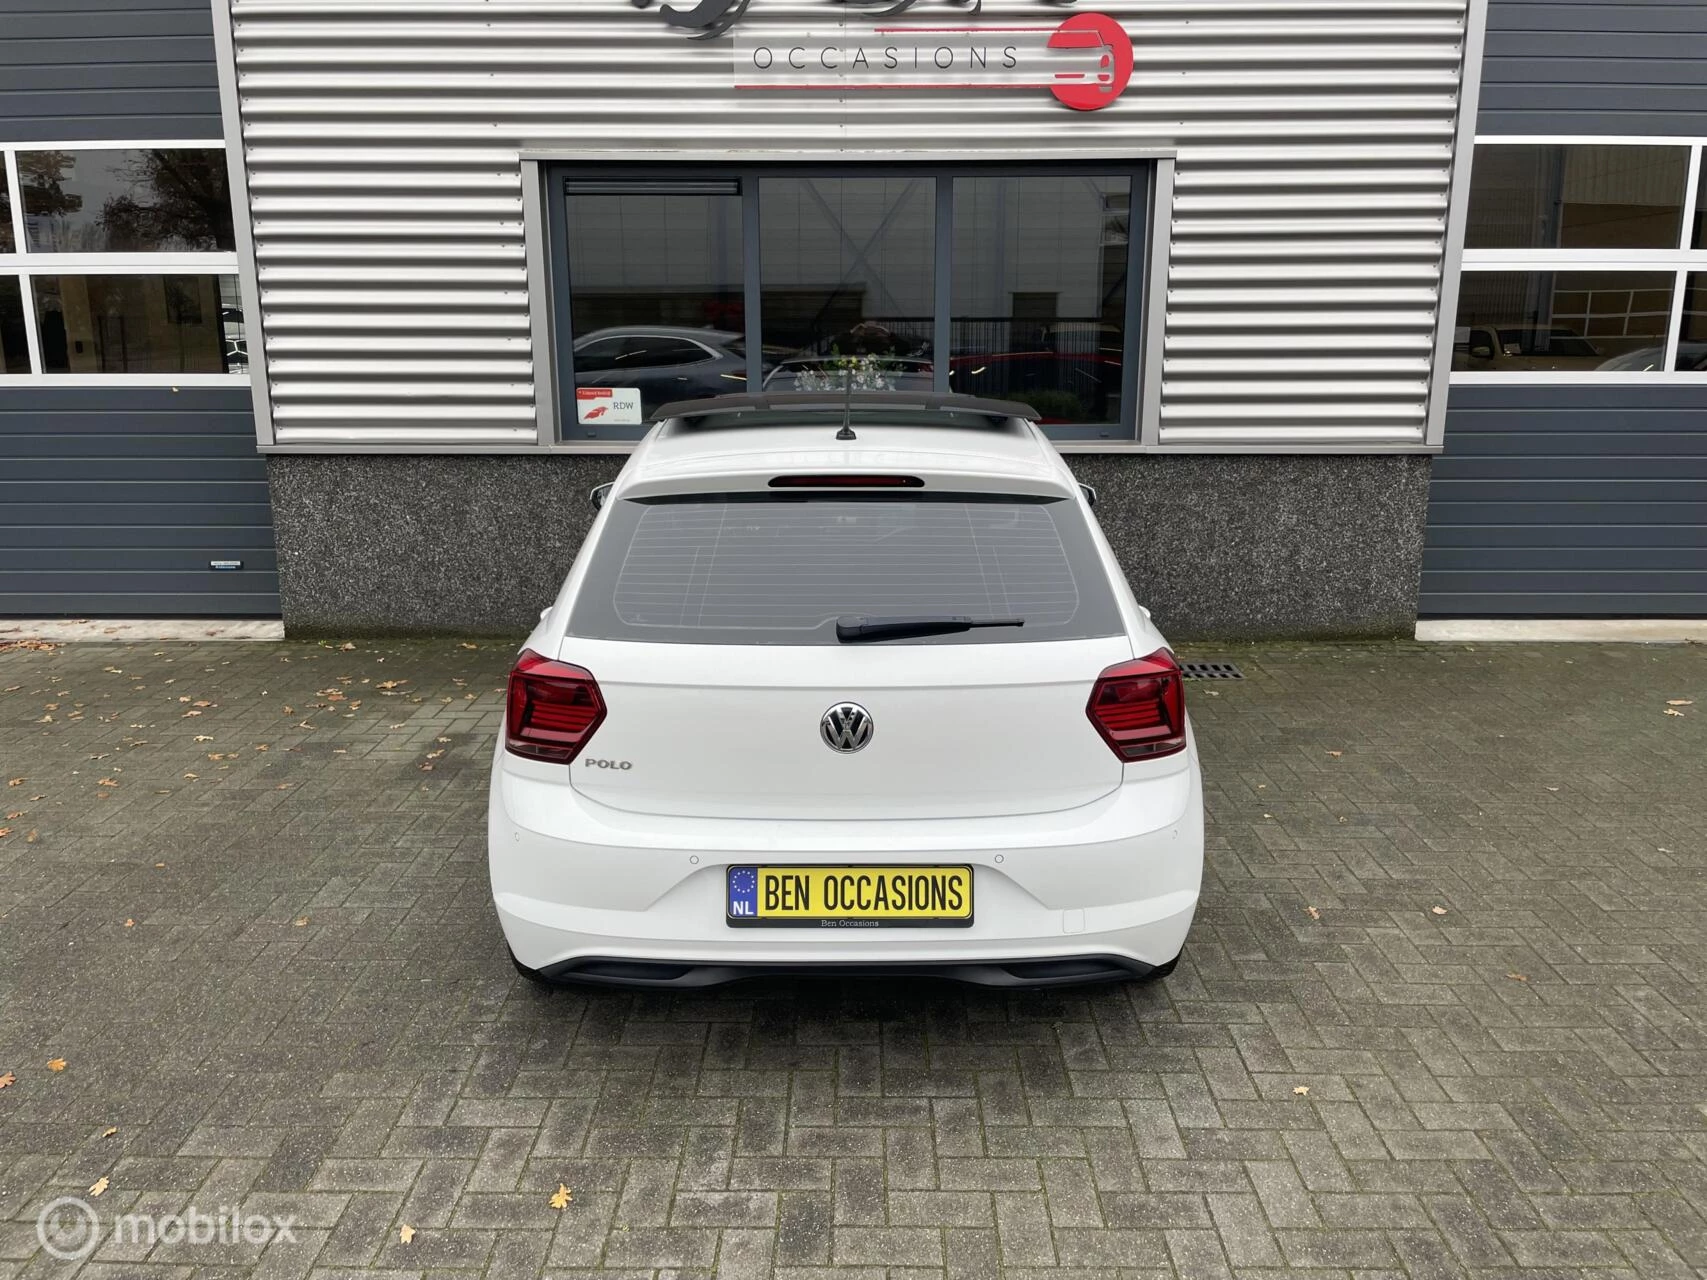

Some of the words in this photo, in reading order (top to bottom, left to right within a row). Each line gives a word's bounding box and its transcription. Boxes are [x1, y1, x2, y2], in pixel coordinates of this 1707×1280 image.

[752, 45, 1018, 71] OCCASIONS
[613, 401, 634, 410] RDW
[585, 758, 632, 771] POLO
[765, 875, 810, 911] BEN
[823, 875, 963, 911] OCCASIONS
[733, 901, 754, 915] NL
[821, 919, 837, 927] Ben
[840, 919, 879, 927] Occasions
